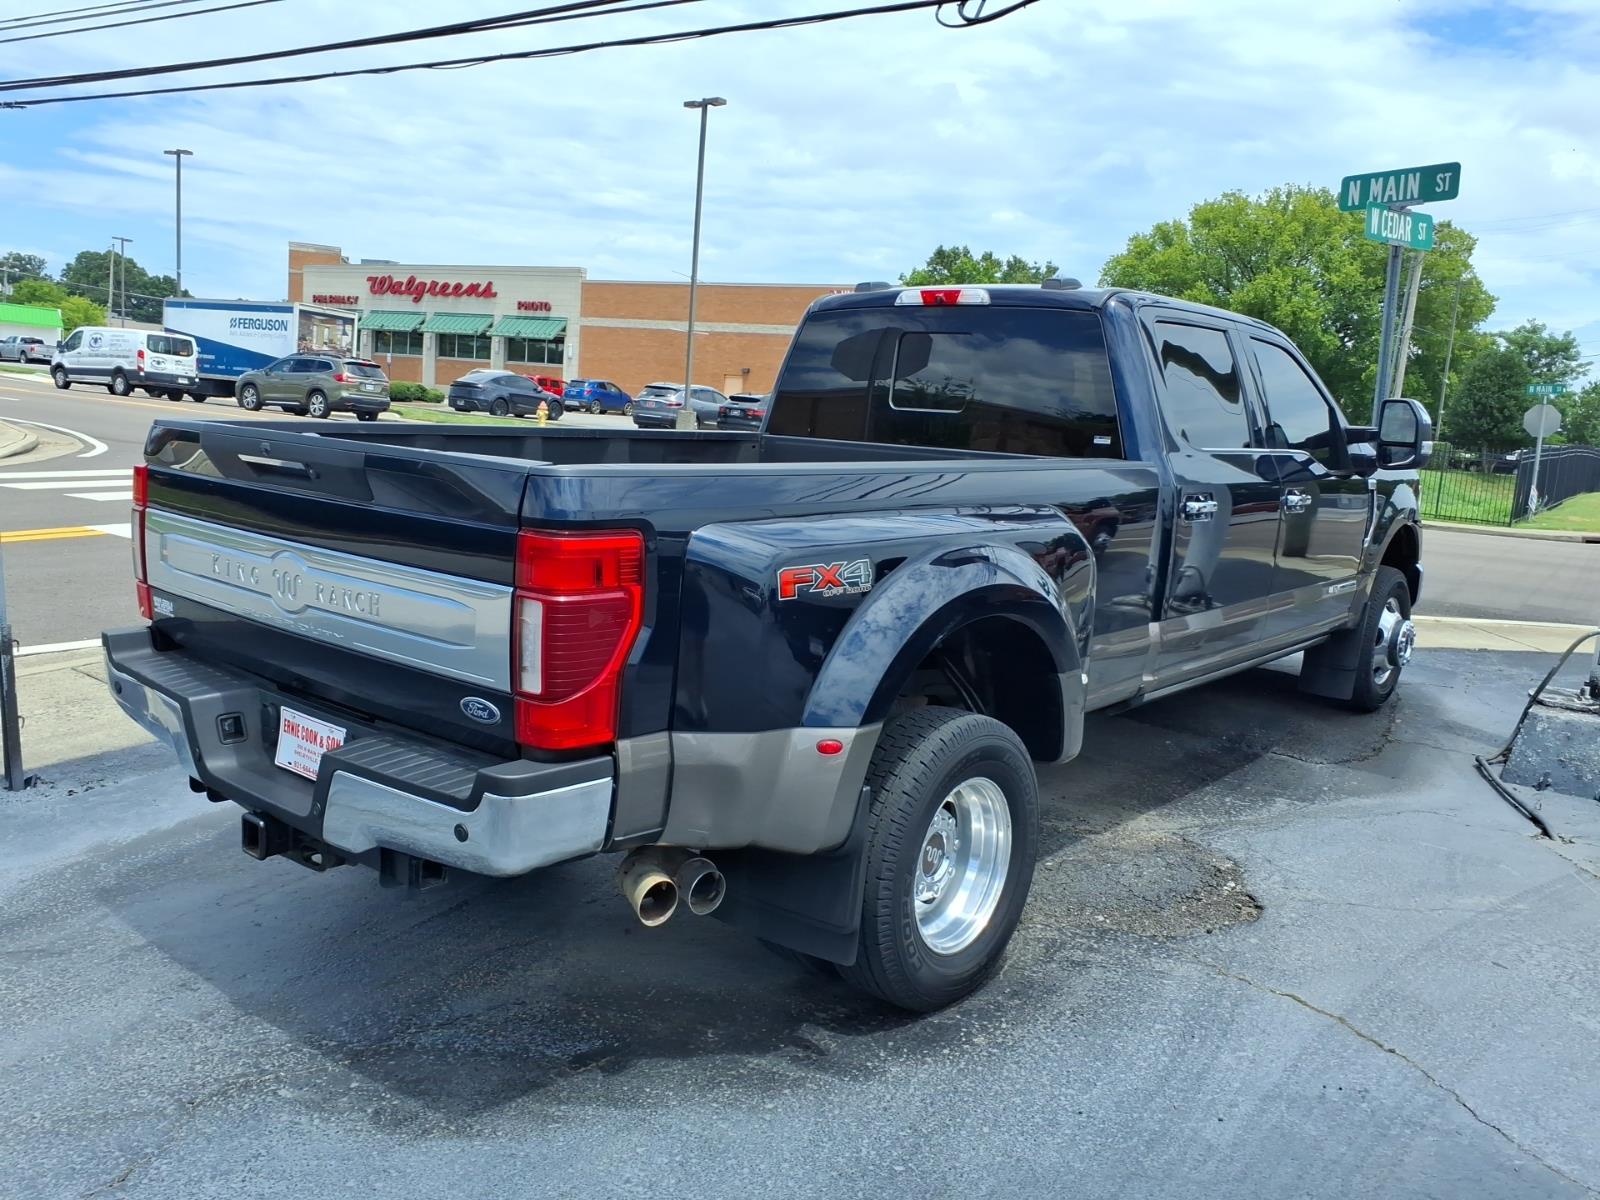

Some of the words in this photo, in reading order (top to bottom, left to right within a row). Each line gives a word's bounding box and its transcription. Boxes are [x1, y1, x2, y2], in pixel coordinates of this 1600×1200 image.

[1347, 180, 1360, 206] N
[1368, 172, 1420, 203] MAIN
[1435, 172, 1452, 192] ST
[1371, 207, 1379, 235] W
[1381, 210, 1412, 242] CEDAR
[1417, 222, 1427, 240] ST
[366, 275, 498, 303] Walgreens
[517, 300, 552, 312] PHOTO
[238, 317, 288, 331] FERGUSON
[212, 552, 260, 585] KING
[315, 581, 381, 617] RANCH
[778, 559, 872, 600] FX4
[467, 701, 489, 719] Ford
[283, 718, 301, 739] ERNIE
[301, 725, 319, 747] COOK
[319, 735, 325, 748] &
